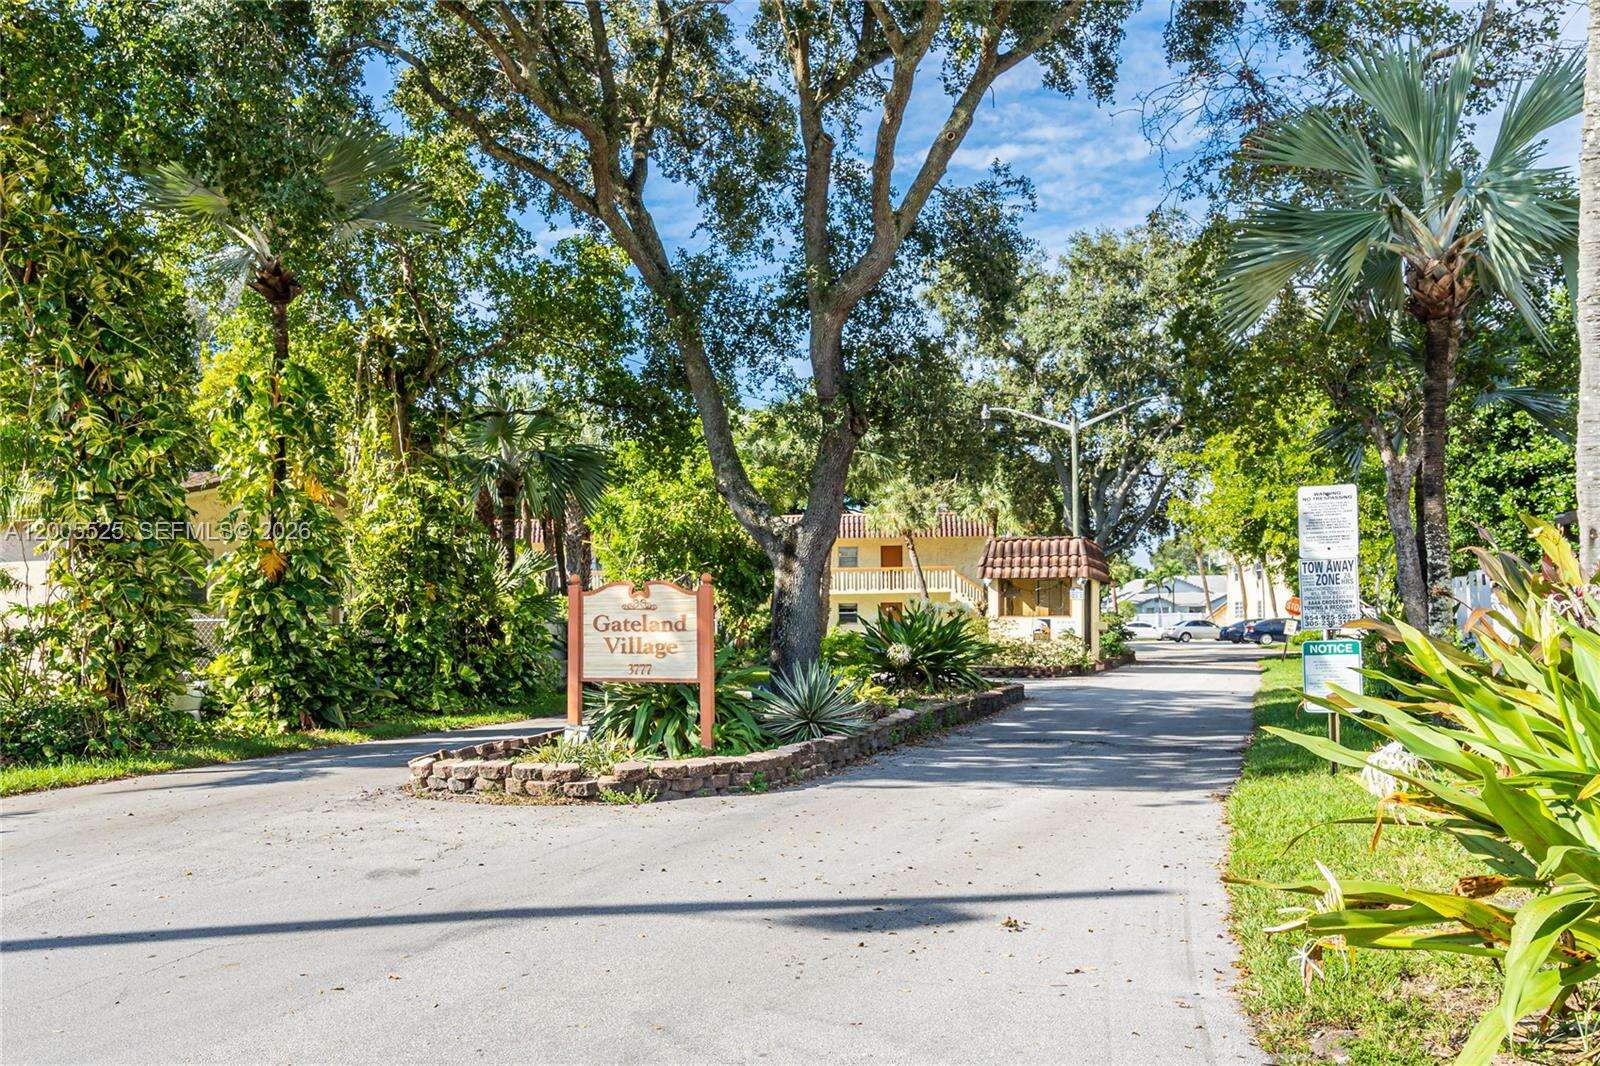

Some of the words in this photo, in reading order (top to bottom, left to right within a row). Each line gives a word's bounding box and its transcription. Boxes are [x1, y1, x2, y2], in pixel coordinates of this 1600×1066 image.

[1302, 561, 1323, 574] TOW
[1326, 559, 1354, 573] AWAY
[1315, 573, 1341, 586] ZONE
[592, 613, 688, 633] Gateland
[603, 637, 678, 659] Village
[1309, 643, 1353, 654] NOTICE
[627, 664, 652, 676] 3777
